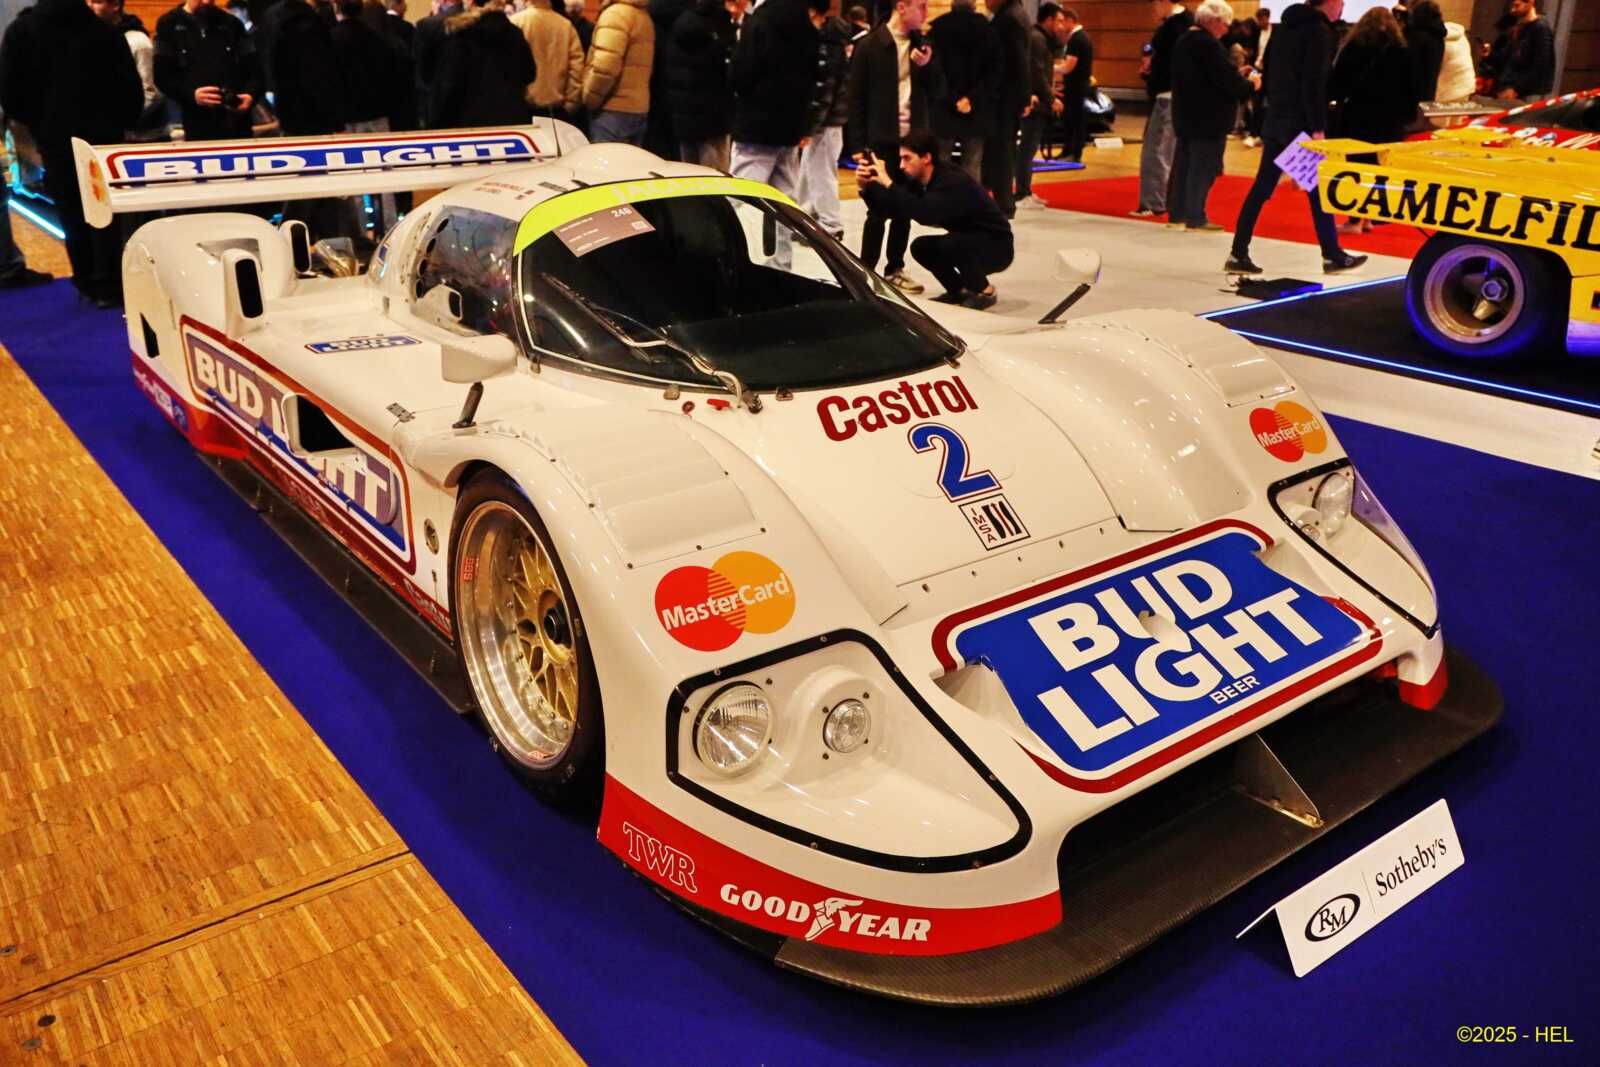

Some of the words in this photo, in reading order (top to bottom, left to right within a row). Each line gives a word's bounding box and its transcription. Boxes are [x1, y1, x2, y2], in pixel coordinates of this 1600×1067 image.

[144, 155, 306, 181] BUD
[325, 143, 515, 170] LIGHT
[194, 347, 264, 418] BUD
[816, 375, 978, 442] Castrol
[907, 422, 1003, 503] 2
[970, 507, 998, 543] IMSA
[661, 573, 790, 631] MasterCard
[1027, 559, 1233, 672] BUD
[1037, 587, 1324, 752] LIGHT
[1209, 675, 1260, 705] BEER
[623, 821, 698, 893] TWR
[1318, 906, 1347, 933] RM
[1375, 838, 1447, 897] Sotheby's
